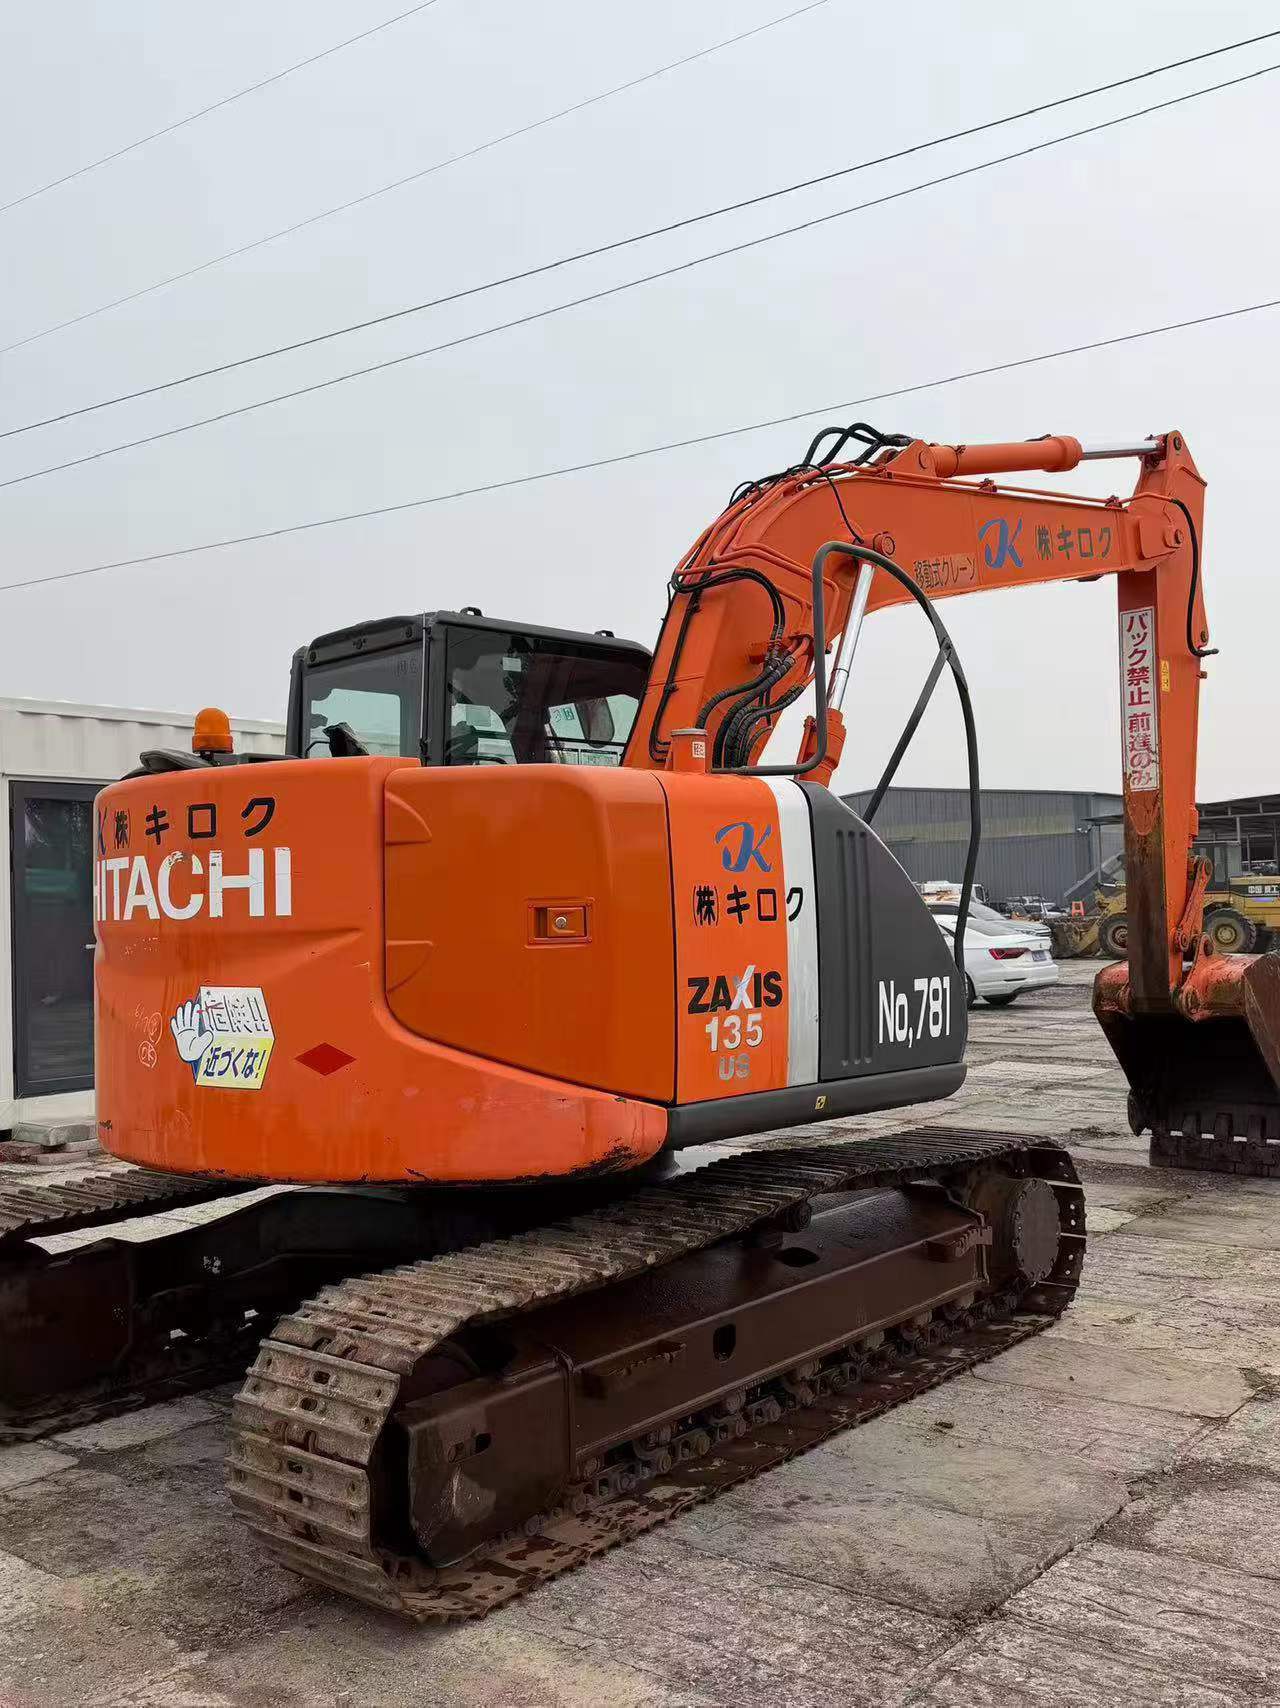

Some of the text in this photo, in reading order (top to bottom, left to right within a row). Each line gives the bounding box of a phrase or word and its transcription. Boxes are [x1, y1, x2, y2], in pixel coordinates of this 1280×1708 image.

[1126, 612, 1150, 706] バック禁止
[692, 884, 804, 926] (株)キロク
[687, 965, 784, 1015] ZAXIS
[705, 1013, 764, 1053] 135
[719, 1053, 751, 1081] US
